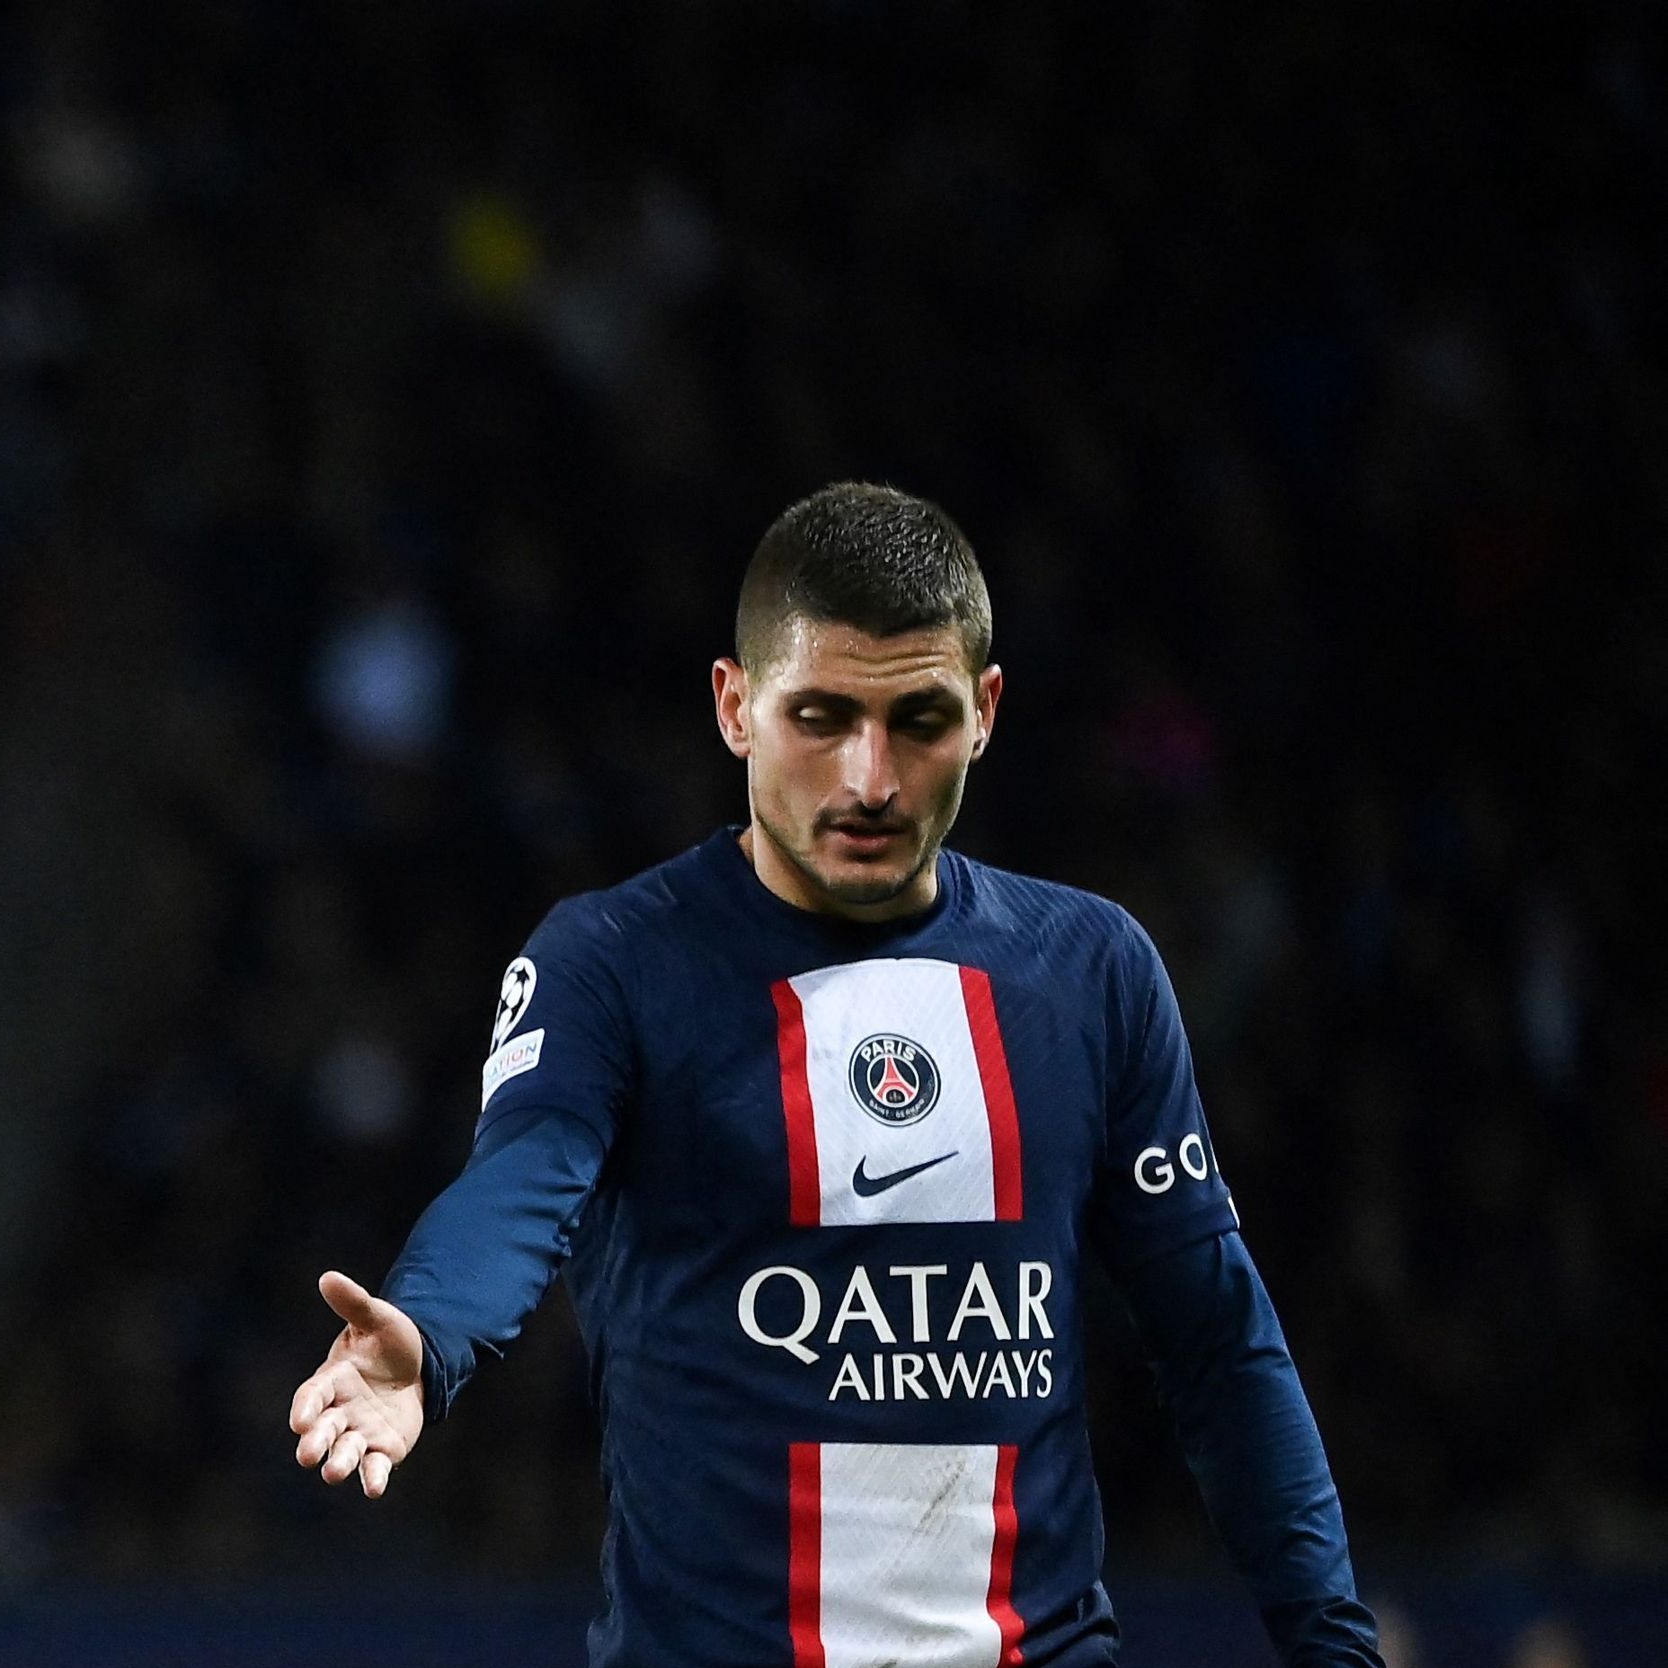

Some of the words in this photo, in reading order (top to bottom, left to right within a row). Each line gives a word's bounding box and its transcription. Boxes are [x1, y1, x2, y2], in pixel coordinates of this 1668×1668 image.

[861, 1040, 917, 1062] PARIS
[1134, 1133, 1218, 1194] GO
[738, 1261, 1054, 1365] QATAR
[828, 1349, 1052, 1401] AIRWAYS
